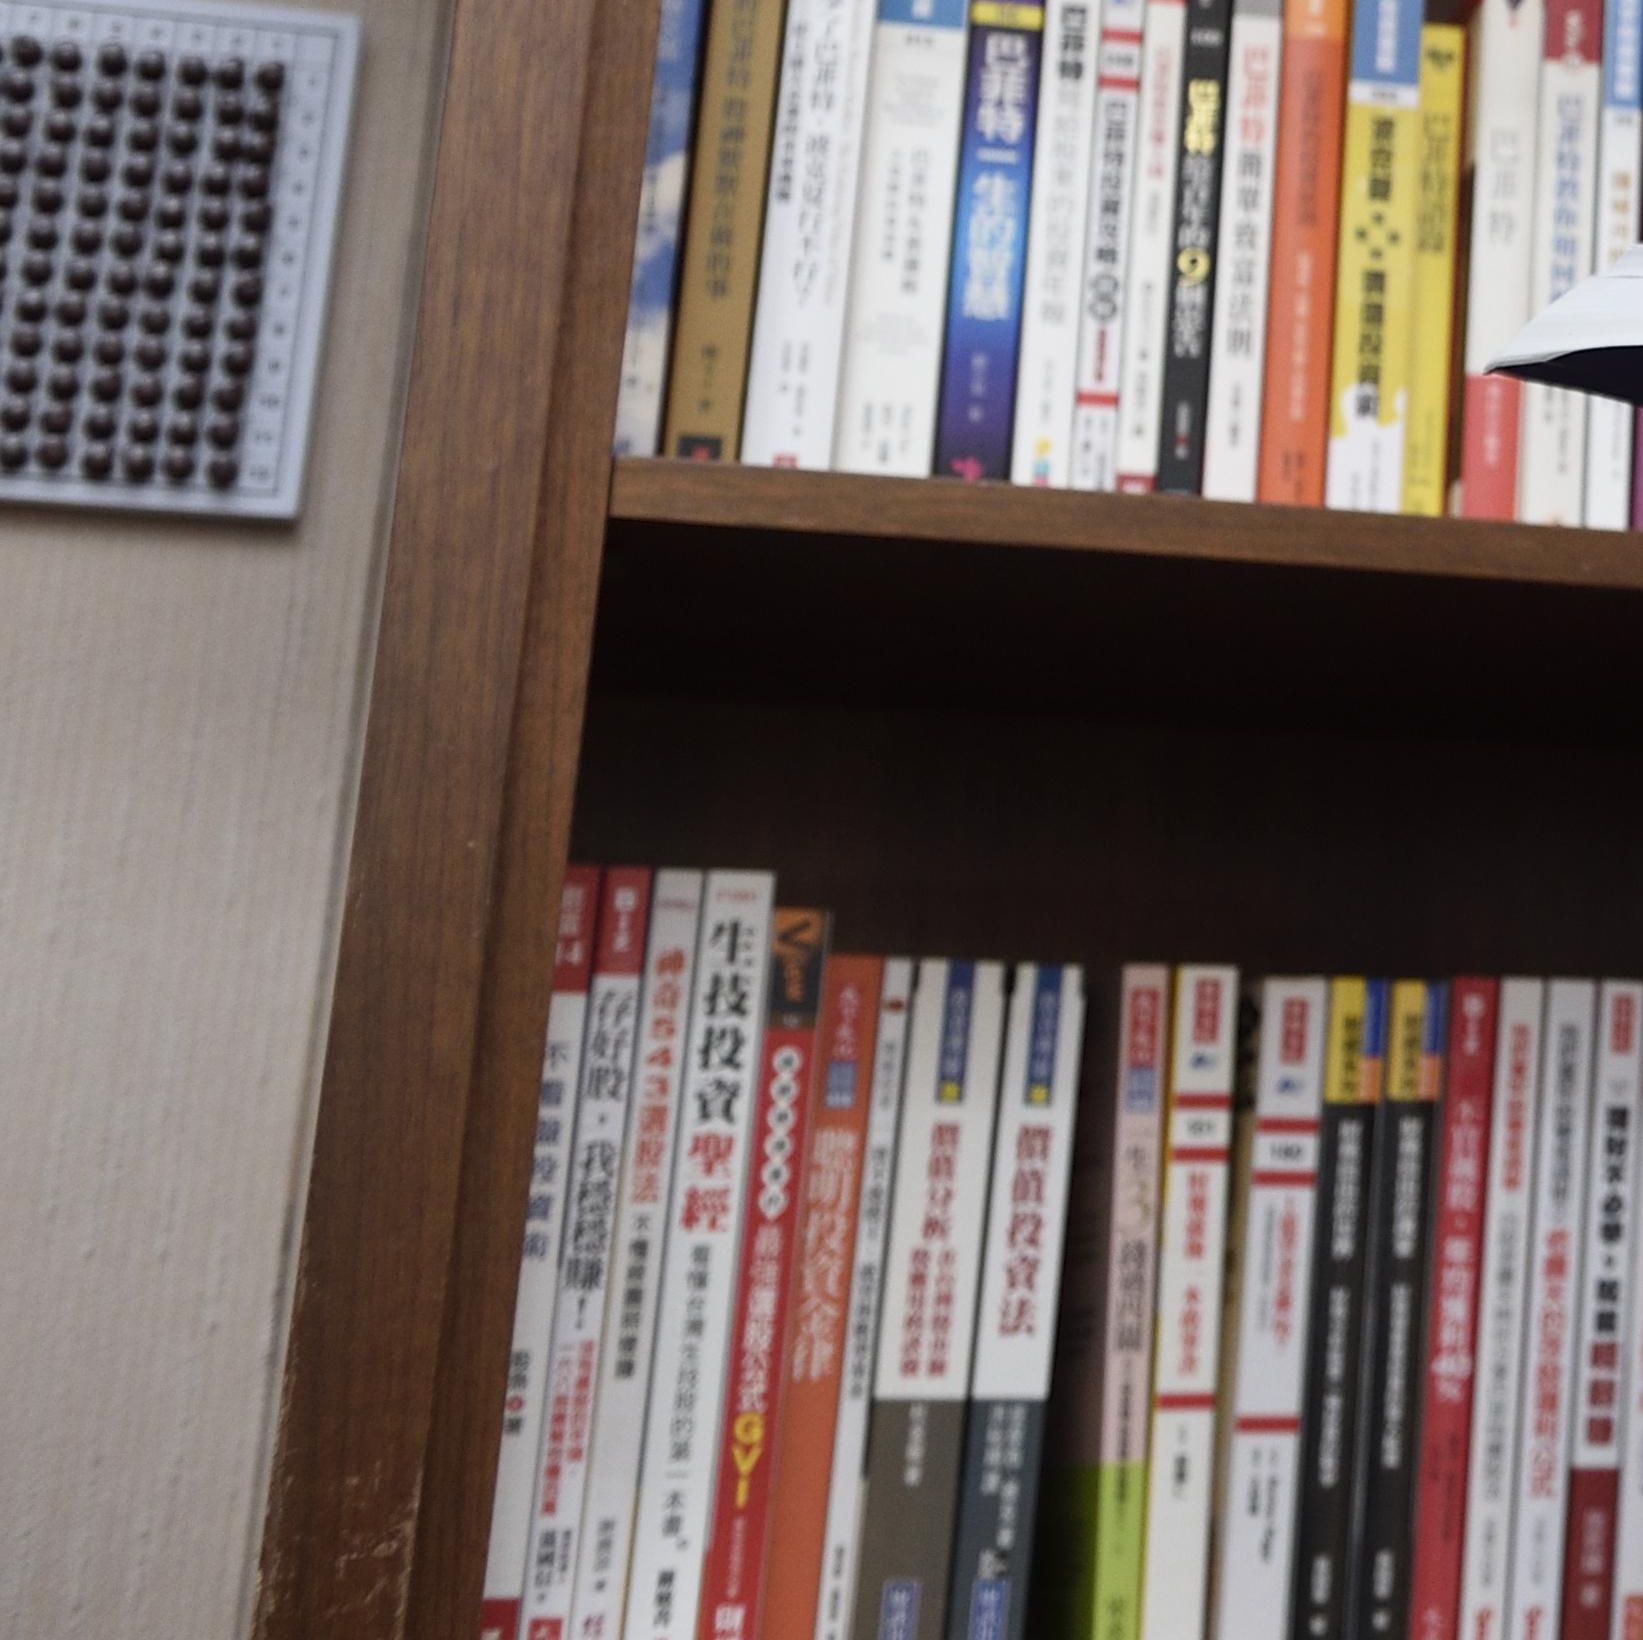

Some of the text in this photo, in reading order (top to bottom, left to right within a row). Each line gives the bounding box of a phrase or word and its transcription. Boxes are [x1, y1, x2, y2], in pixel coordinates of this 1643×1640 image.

[679, 916, 757, 1234] 生技投資聖經
[998, 1123, 1053, 1339] 價值投資法
